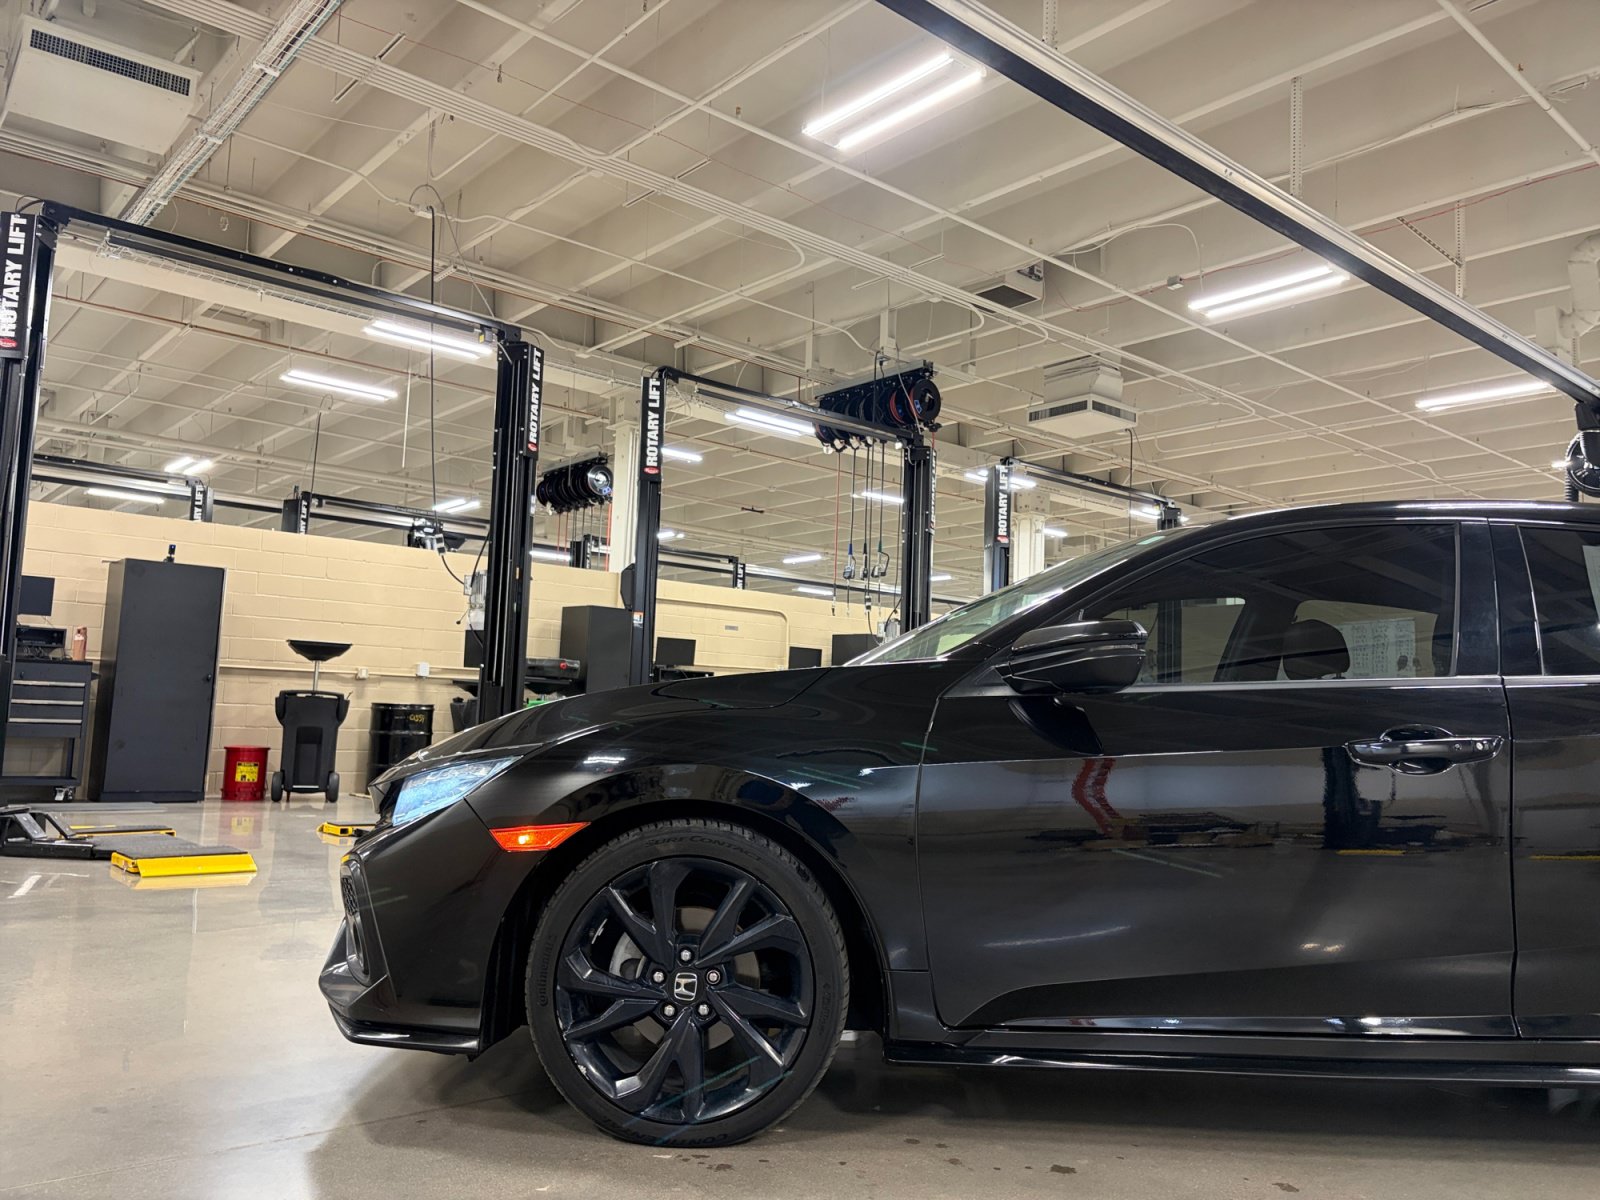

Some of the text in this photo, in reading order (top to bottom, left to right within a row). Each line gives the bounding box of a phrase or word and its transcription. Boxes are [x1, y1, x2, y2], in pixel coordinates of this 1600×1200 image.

[7, 214, 27, 255] LIFT
[0, 259, 22, 338] ROTARY
[532, 347, 542, 380] LIFT
[529, 382, 540, 443] ROTARY
[648, 378, 661, 408] LIFT
[646, 411, 660, 466] ROTARY
[195, 485, 204, 505] LIFT
[998, 466, 1009, 535] ROTARY LIFT
